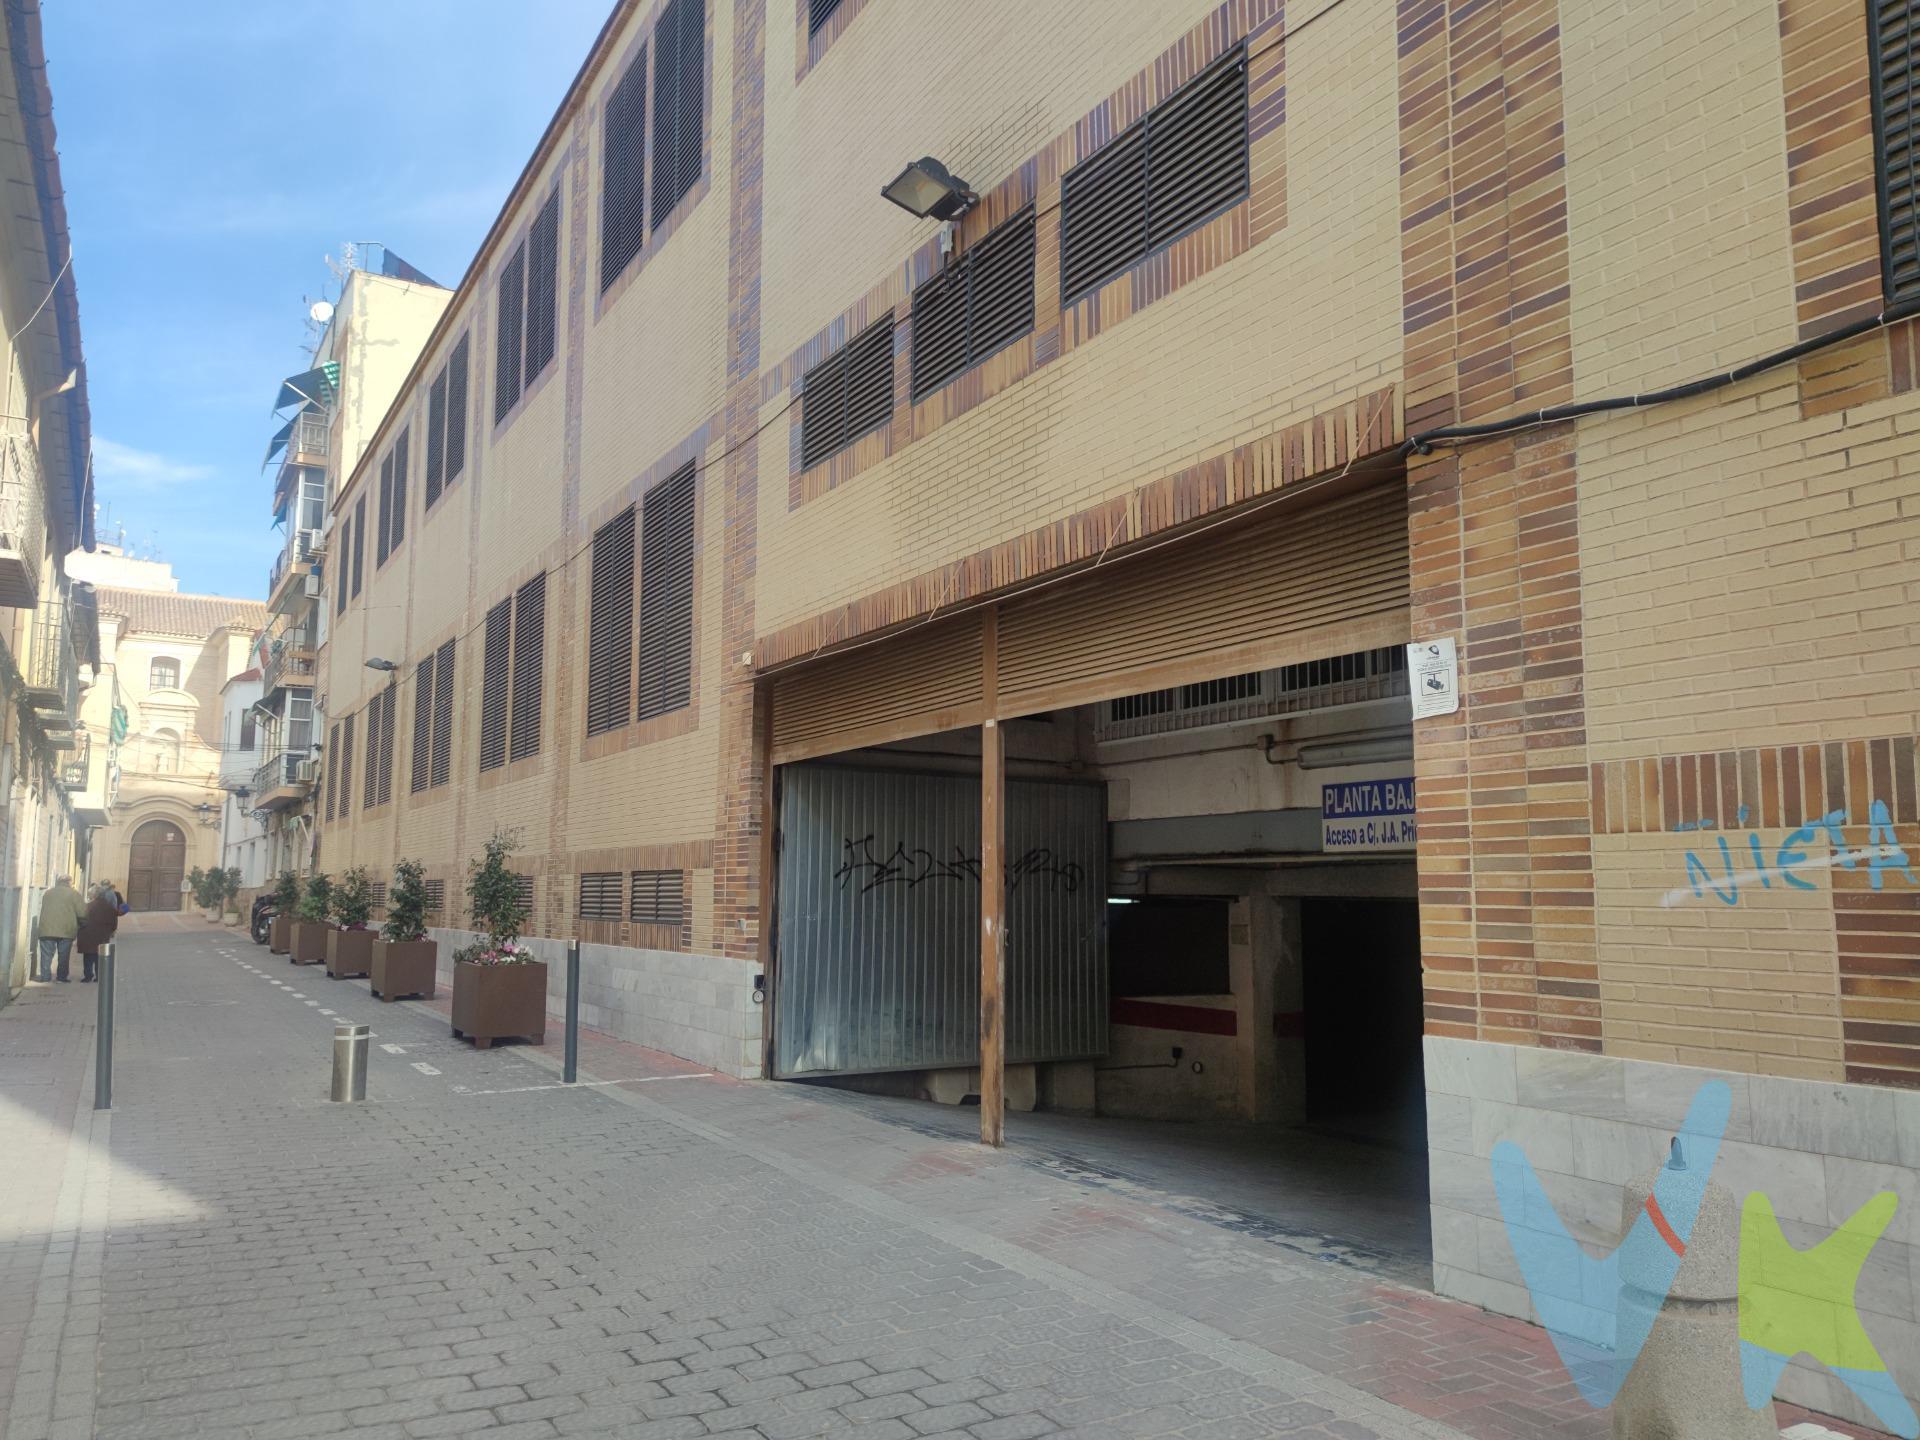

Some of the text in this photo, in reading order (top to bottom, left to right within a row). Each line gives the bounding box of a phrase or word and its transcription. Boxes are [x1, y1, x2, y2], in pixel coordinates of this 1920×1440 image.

[1325, 785, 1381, 814] PLANTA
[1326, 825, 1357, 845] Acceso
[1360, 828, 1365, 844] a
